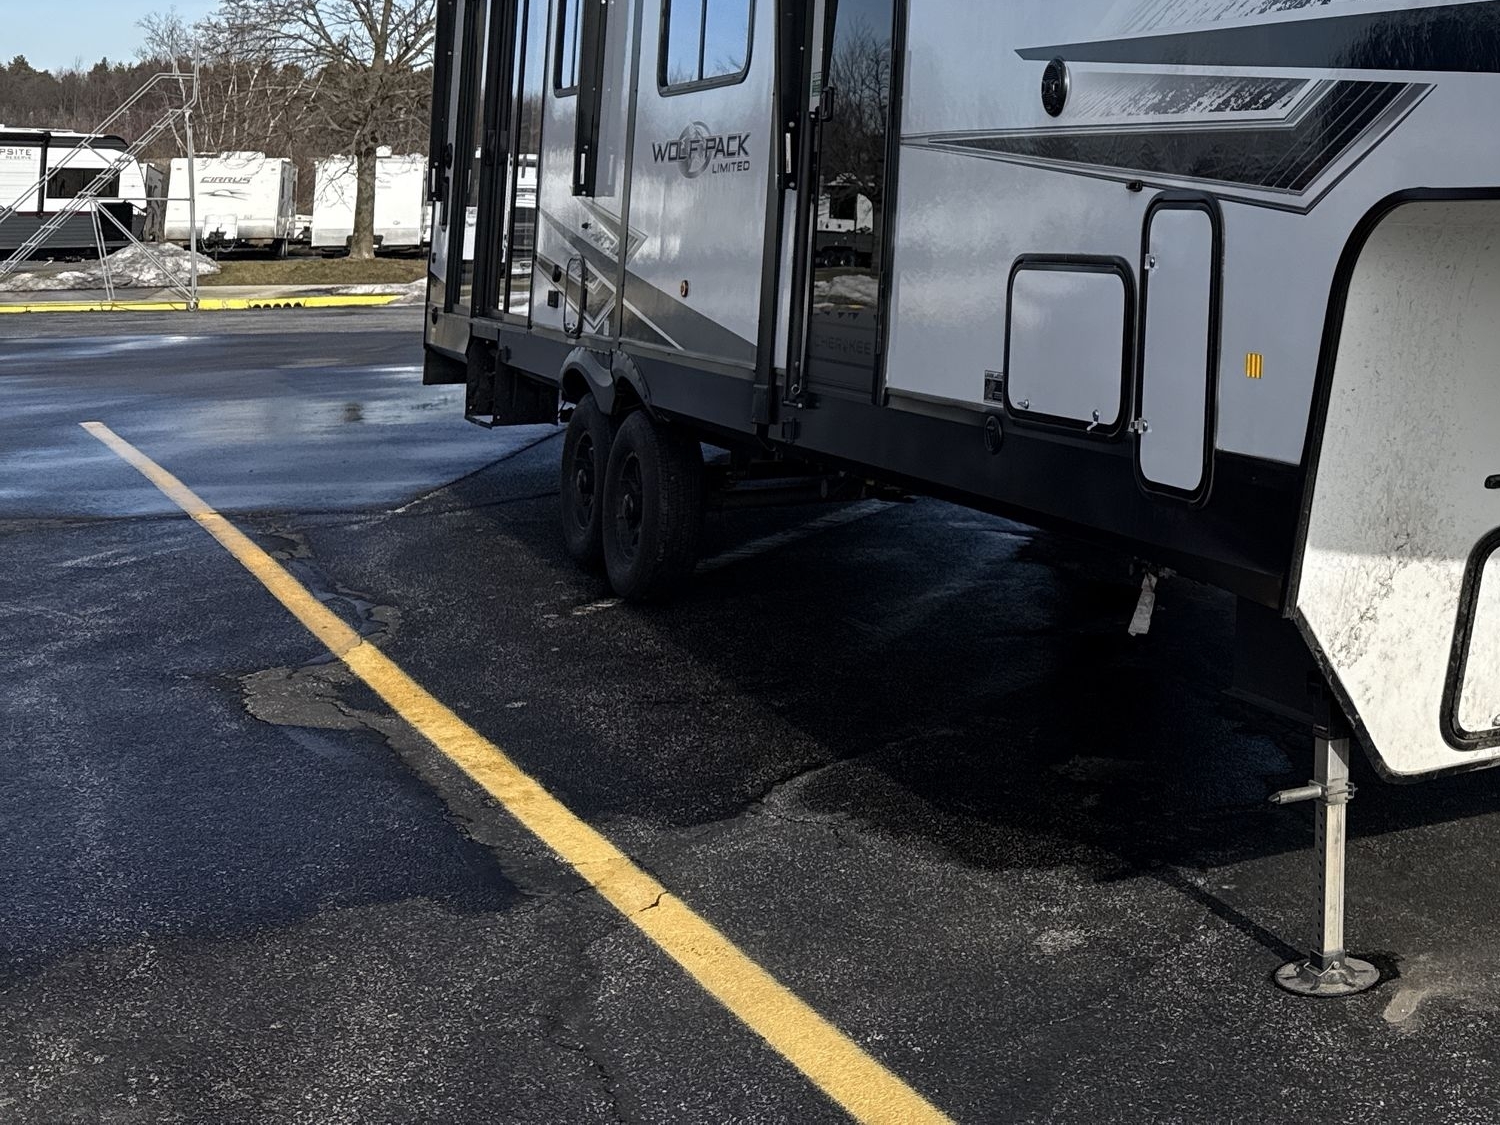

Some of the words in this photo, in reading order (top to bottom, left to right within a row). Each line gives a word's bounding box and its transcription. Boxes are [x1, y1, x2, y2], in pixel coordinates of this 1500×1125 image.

[652, 138, 704, 164] WOLF
[705, 131, 751, 160] PACK
[712, 160, 750, 174] LIMITED
[200, 176, 252, 184] CIRRUS
